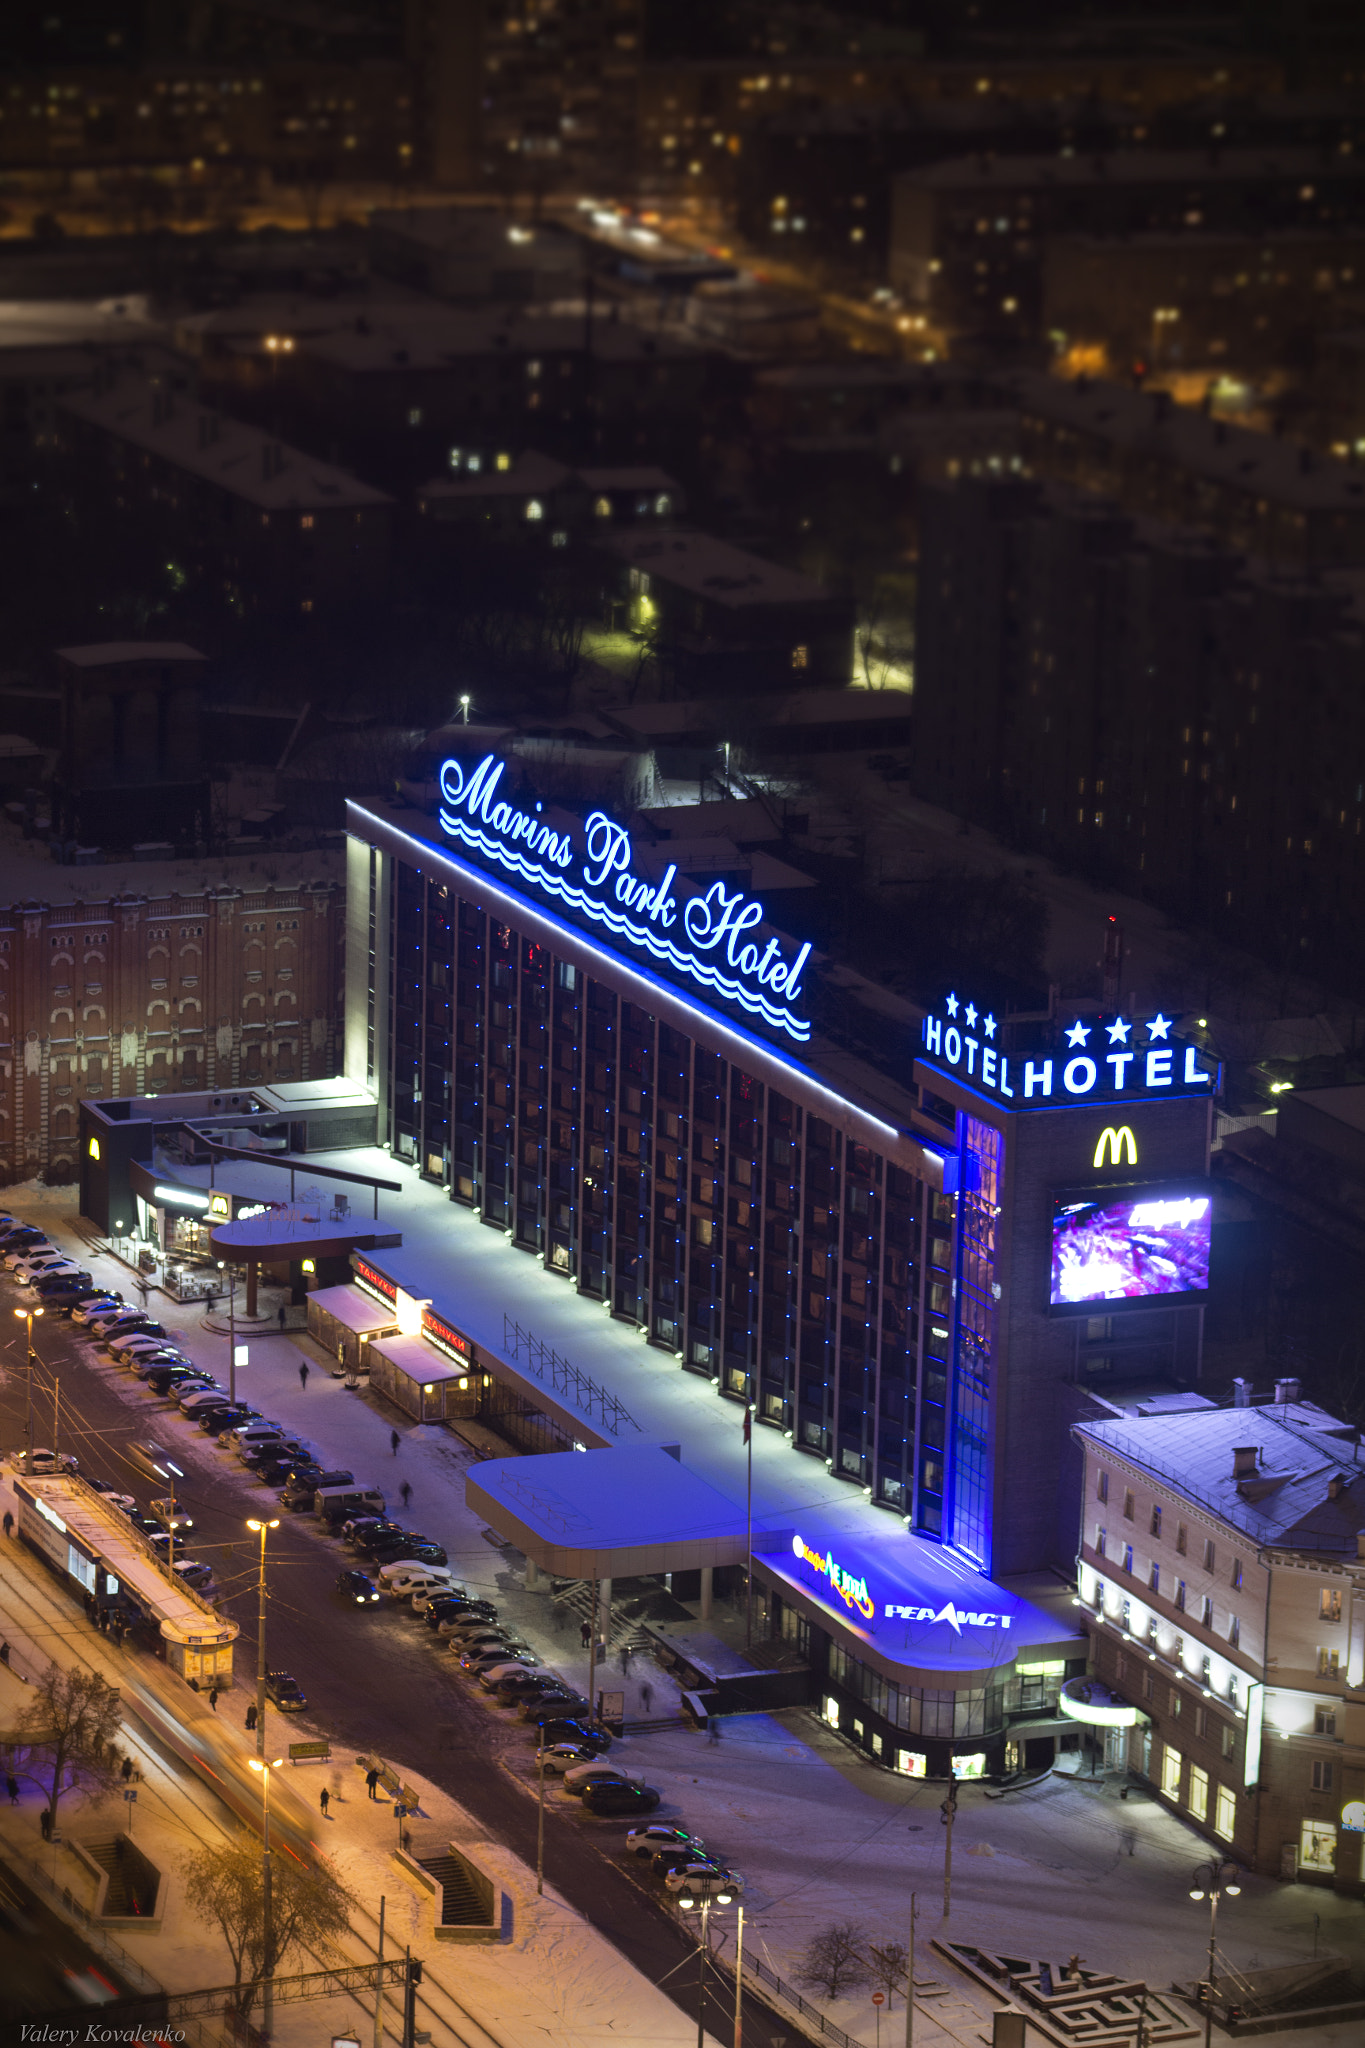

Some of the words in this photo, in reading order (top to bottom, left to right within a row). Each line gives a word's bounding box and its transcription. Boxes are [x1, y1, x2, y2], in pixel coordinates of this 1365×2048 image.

[441, 754, 573, 868] Marins
[583, 811, 677, 928] Park
[684, 881, 812, 1001] Hotel
[926, 1015, 1014, 1098] HOTEL
[1024, 1047, 1209, 1098] HOTEL
[358, 1262, 396, 1298] ТАНУКИ
[425, 1313, 466, 1352] ТАНУКИ
